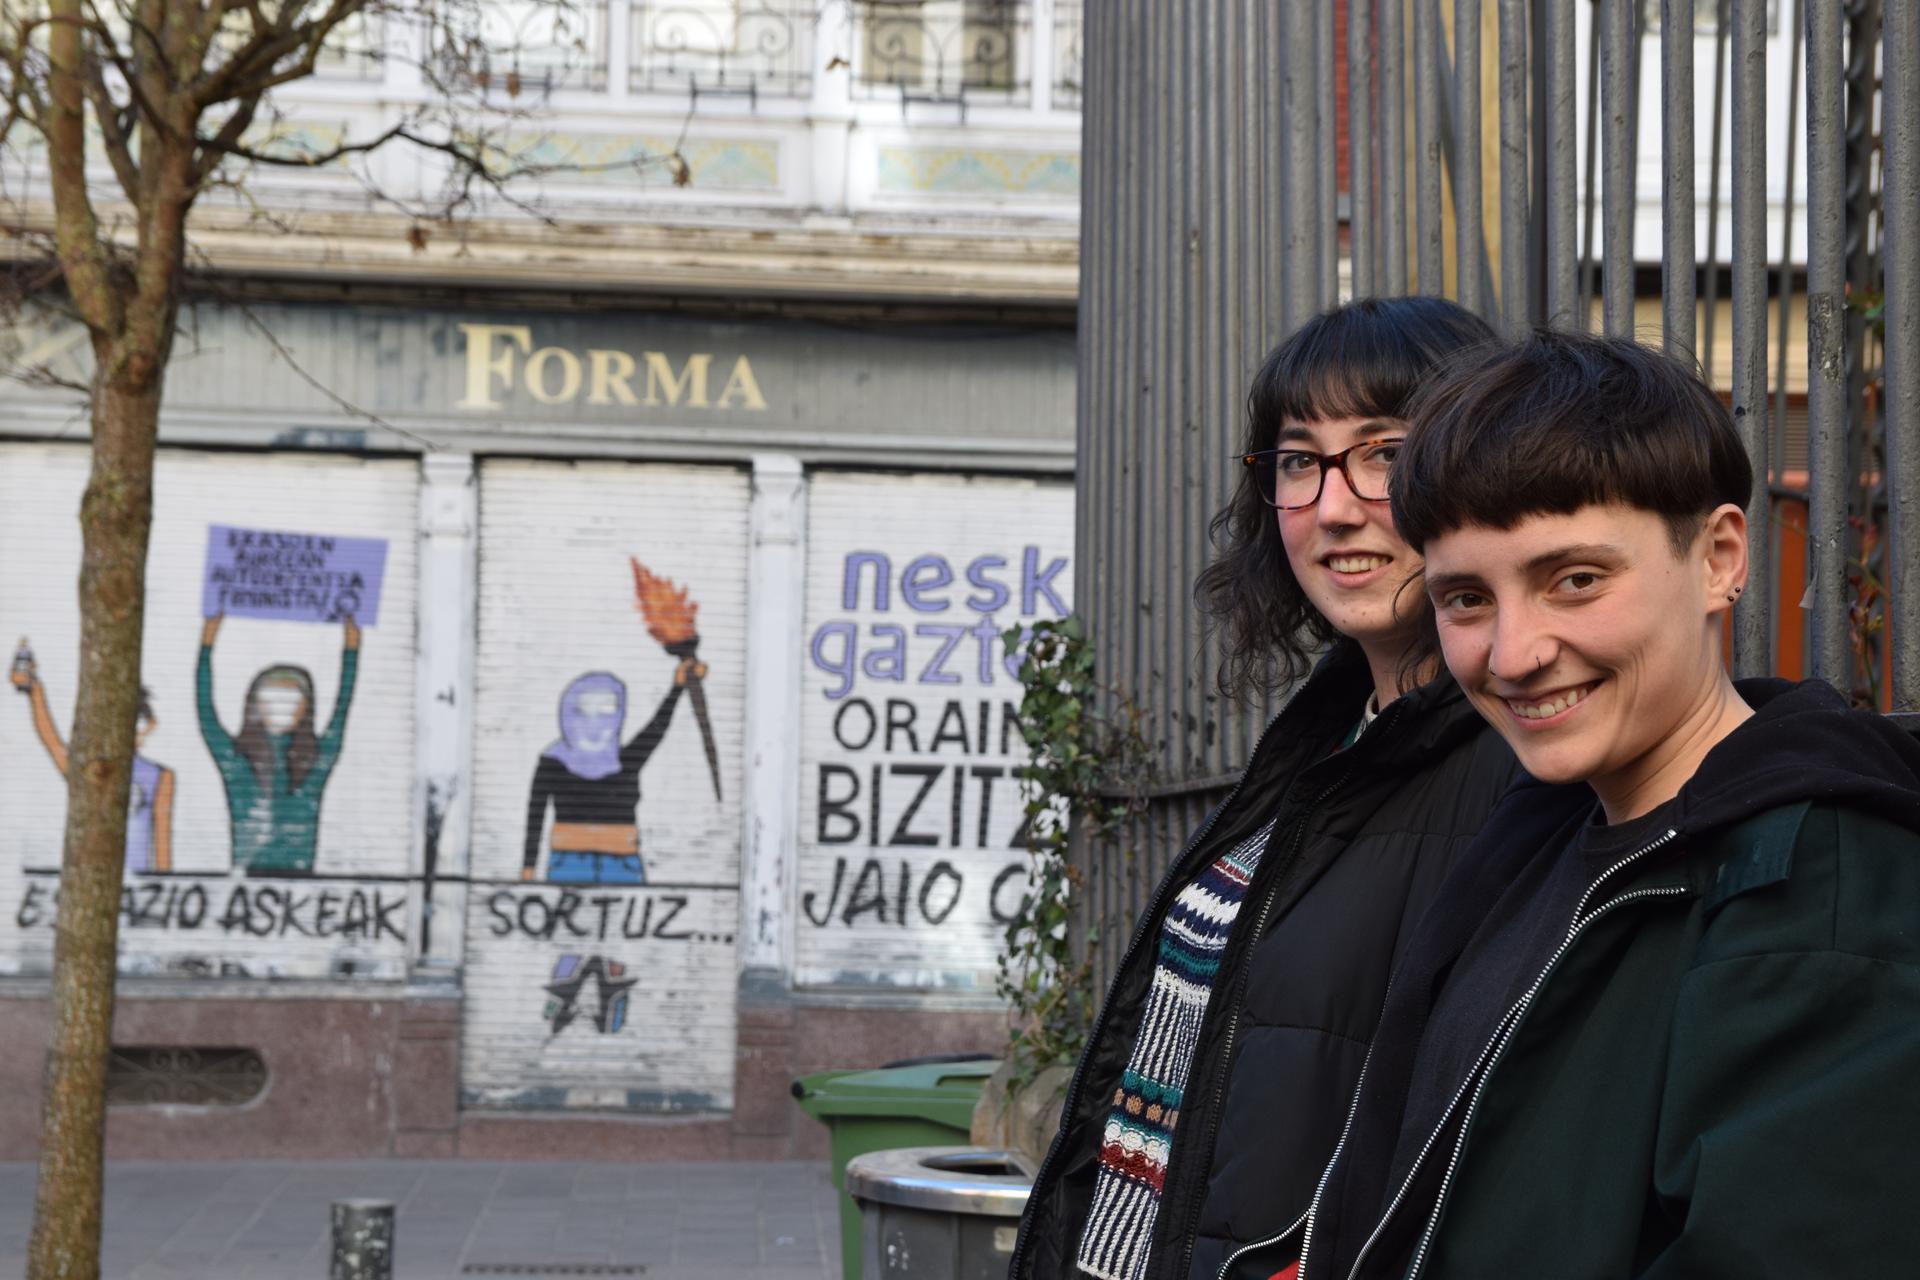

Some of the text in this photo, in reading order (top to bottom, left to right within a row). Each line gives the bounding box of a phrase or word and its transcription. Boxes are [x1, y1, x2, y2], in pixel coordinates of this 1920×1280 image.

[455, 322, 768, 411] FORMA
[217, 884, 407, 942] ASKEAK
[804, 857, 962, 928] JAIO
